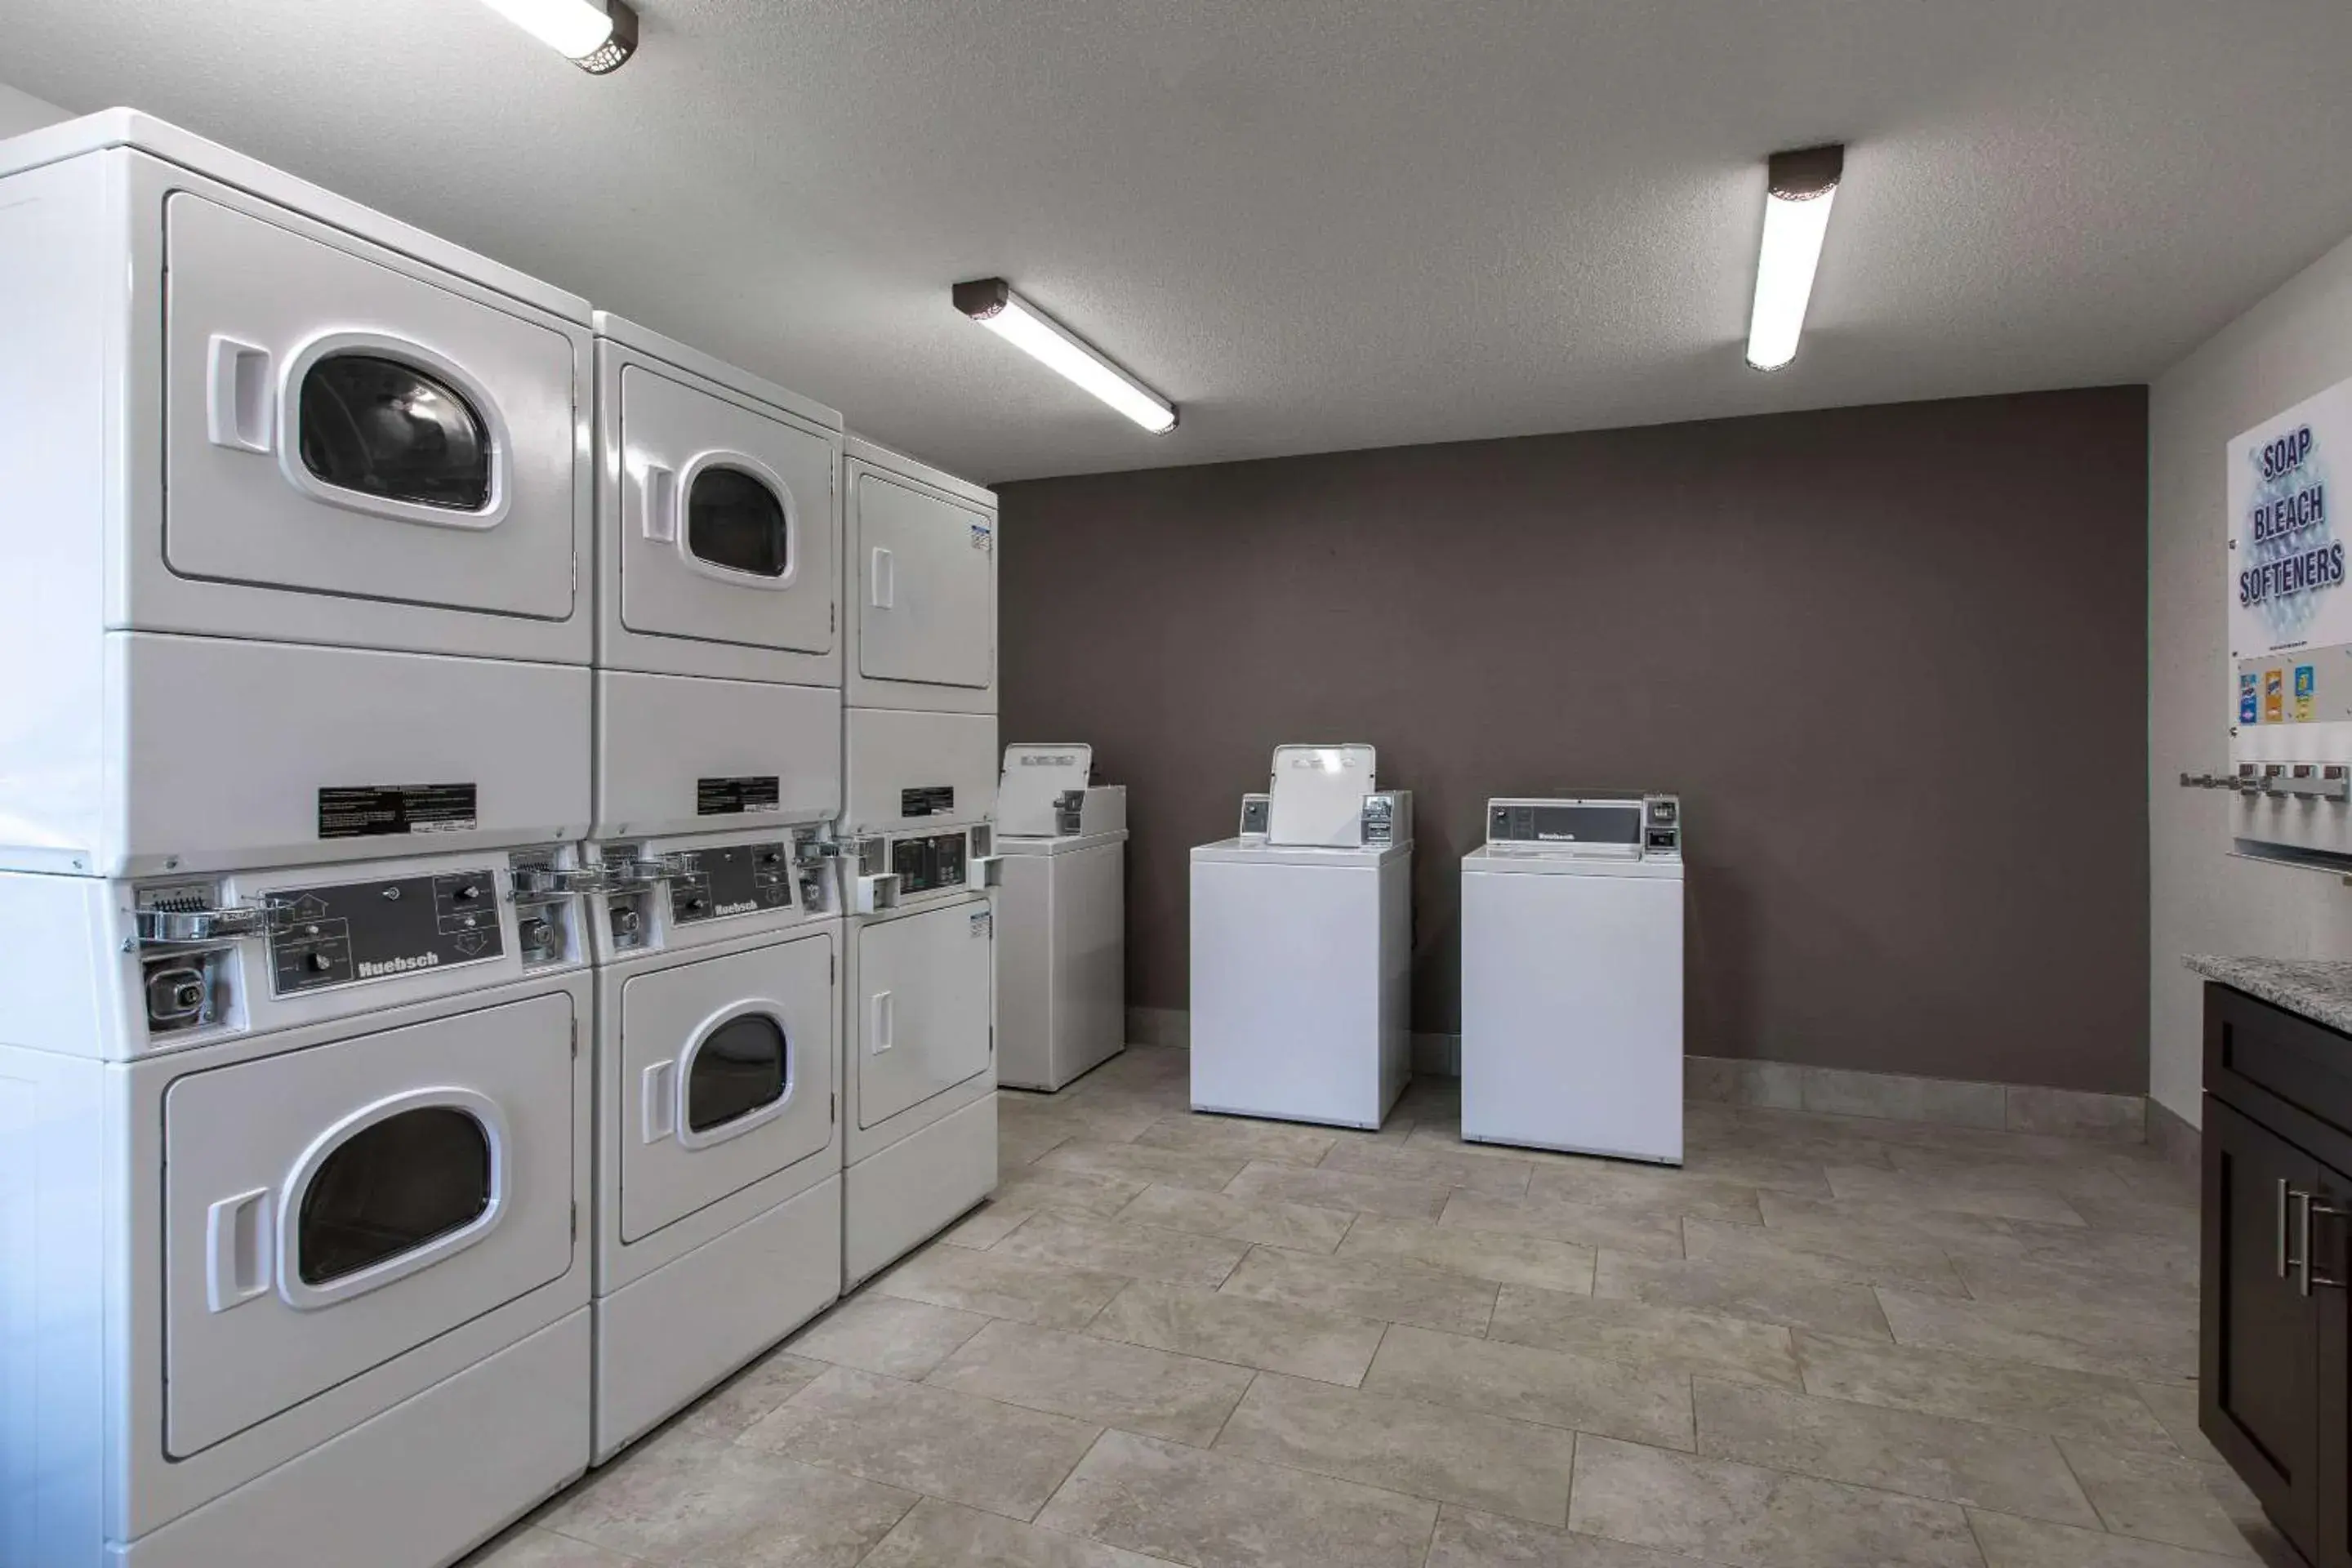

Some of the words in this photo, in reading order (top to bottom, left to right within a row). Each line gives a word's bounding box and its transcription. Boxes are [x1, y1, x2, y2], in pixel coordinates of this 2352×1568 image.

[2263, 426, 2312, 479] SOAP
[2253, 484, 2323, 541] BLEACH
[2239, 542, 2344, 604] SOFTENERS
[358, 951, 439, 978] Huebsch
